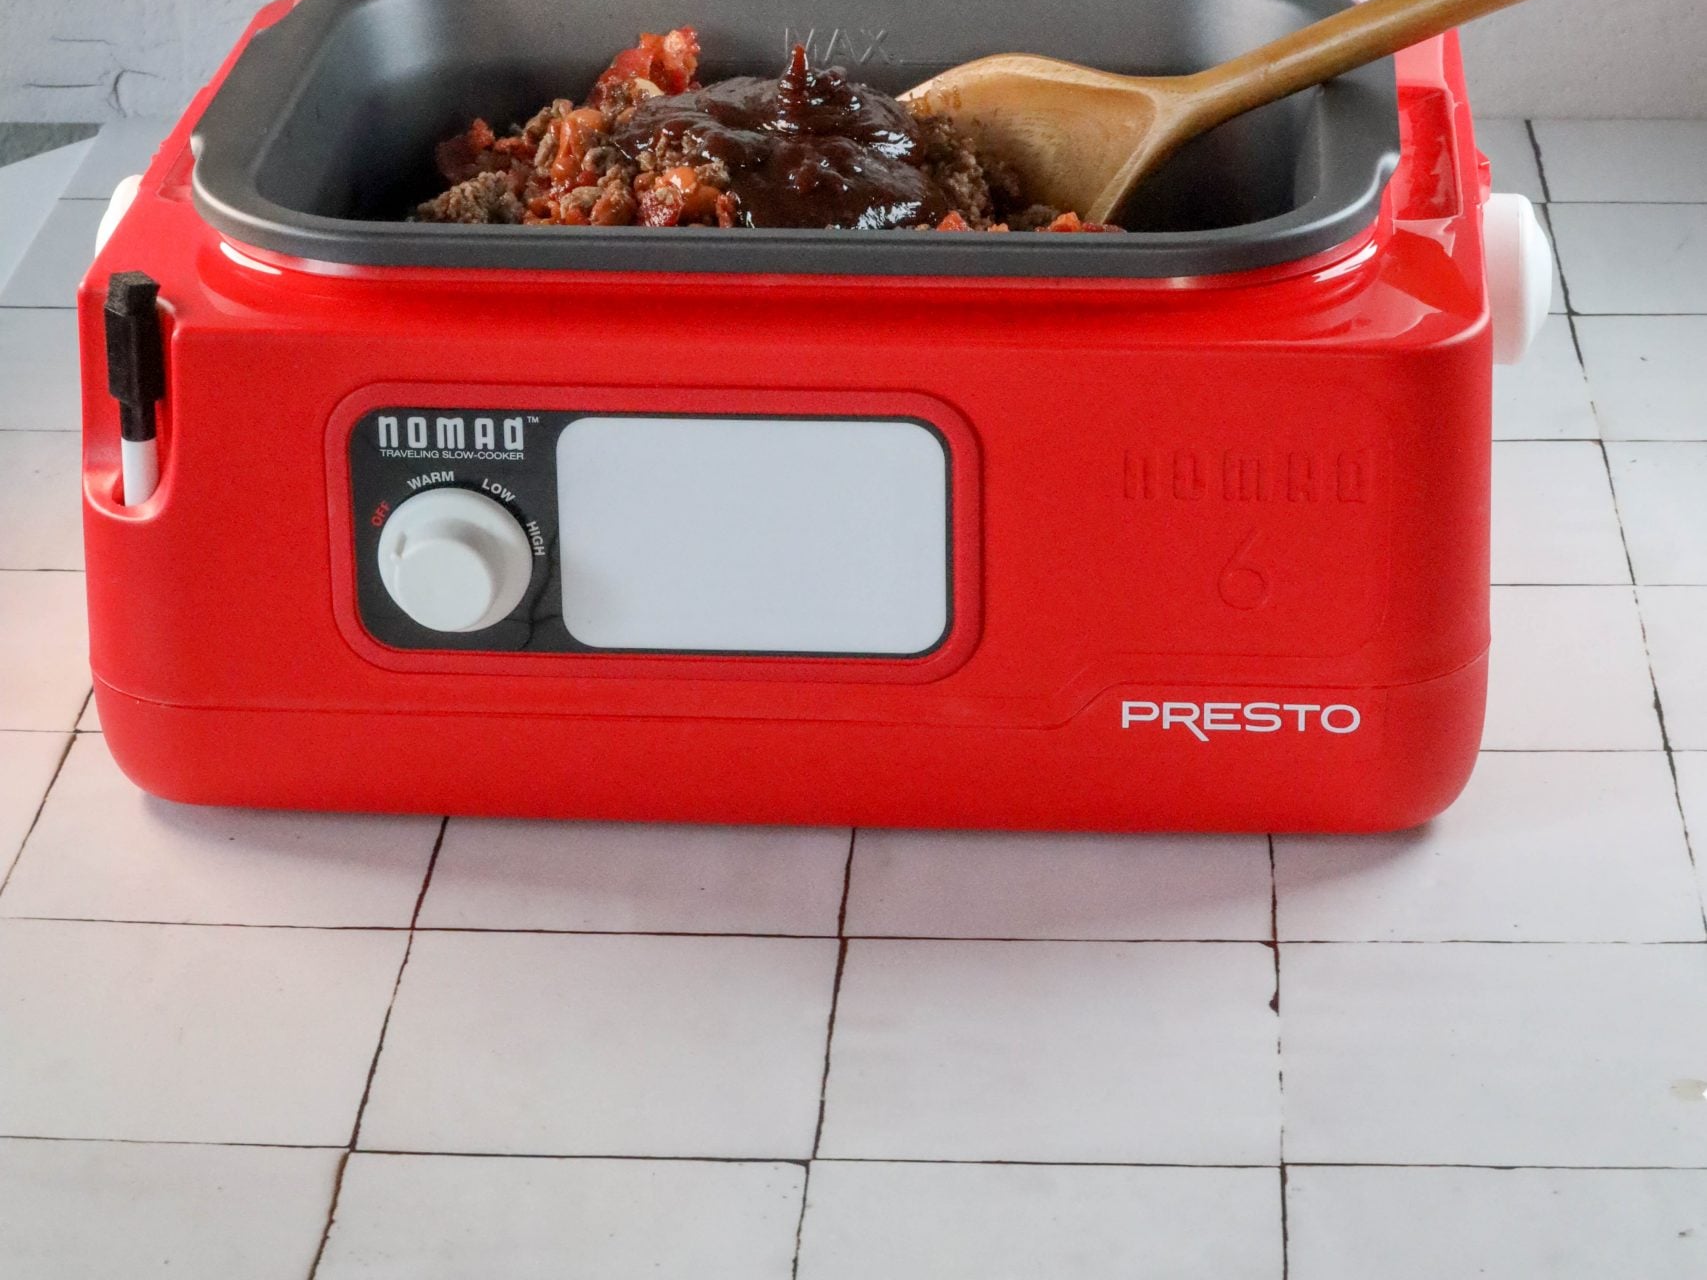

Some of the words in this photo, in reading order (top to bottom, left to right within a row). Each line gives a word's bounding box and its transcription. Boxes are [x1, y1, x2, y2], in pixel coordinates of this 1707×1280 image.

[784, 28, 893, 64] MAX
[378, 416, 524, 450] NOMAD
[380, 449, 440, 459] TRAVELING
[441, 450, 524, 461] SLOW-COOKER
[407, 470, 455, 490] WARM
[482, 478, 516, 503] LOW
[371, 501, 390, 527] OFF
[526, 521, 546, 556] HIGH
[1121, 700, 1362, 742] PRESTO
